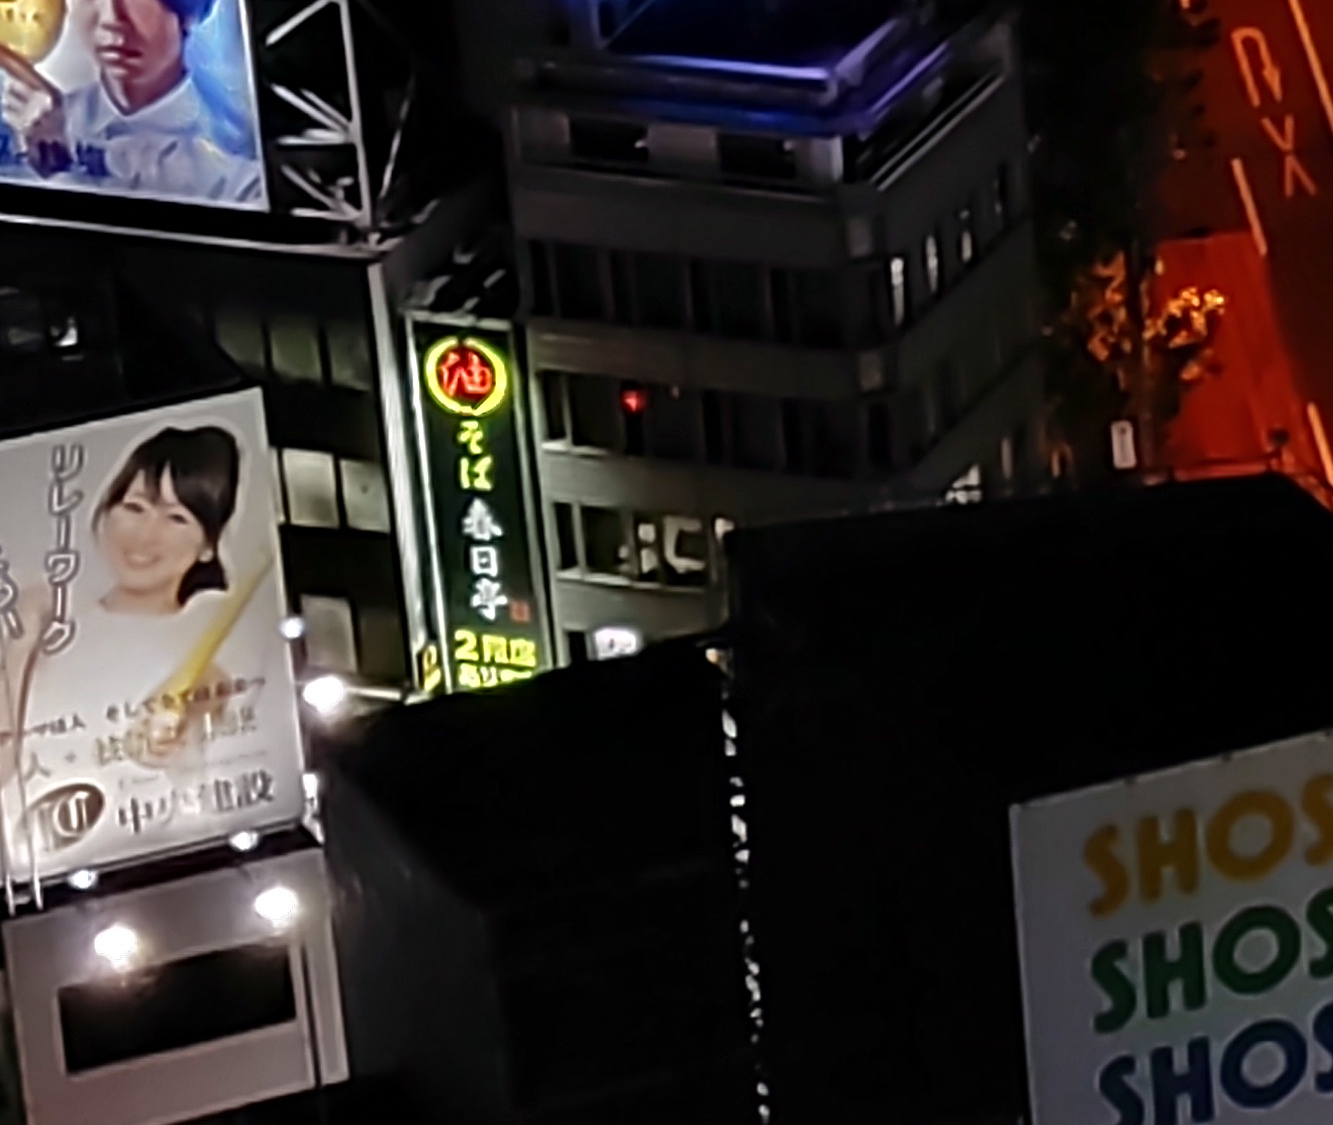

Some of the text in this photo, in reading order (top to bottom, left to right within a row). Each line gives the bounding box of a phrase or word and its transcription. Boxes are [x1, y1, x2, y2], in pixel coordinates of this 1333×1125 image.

[41, 444, 84, 656] リレーワーク
